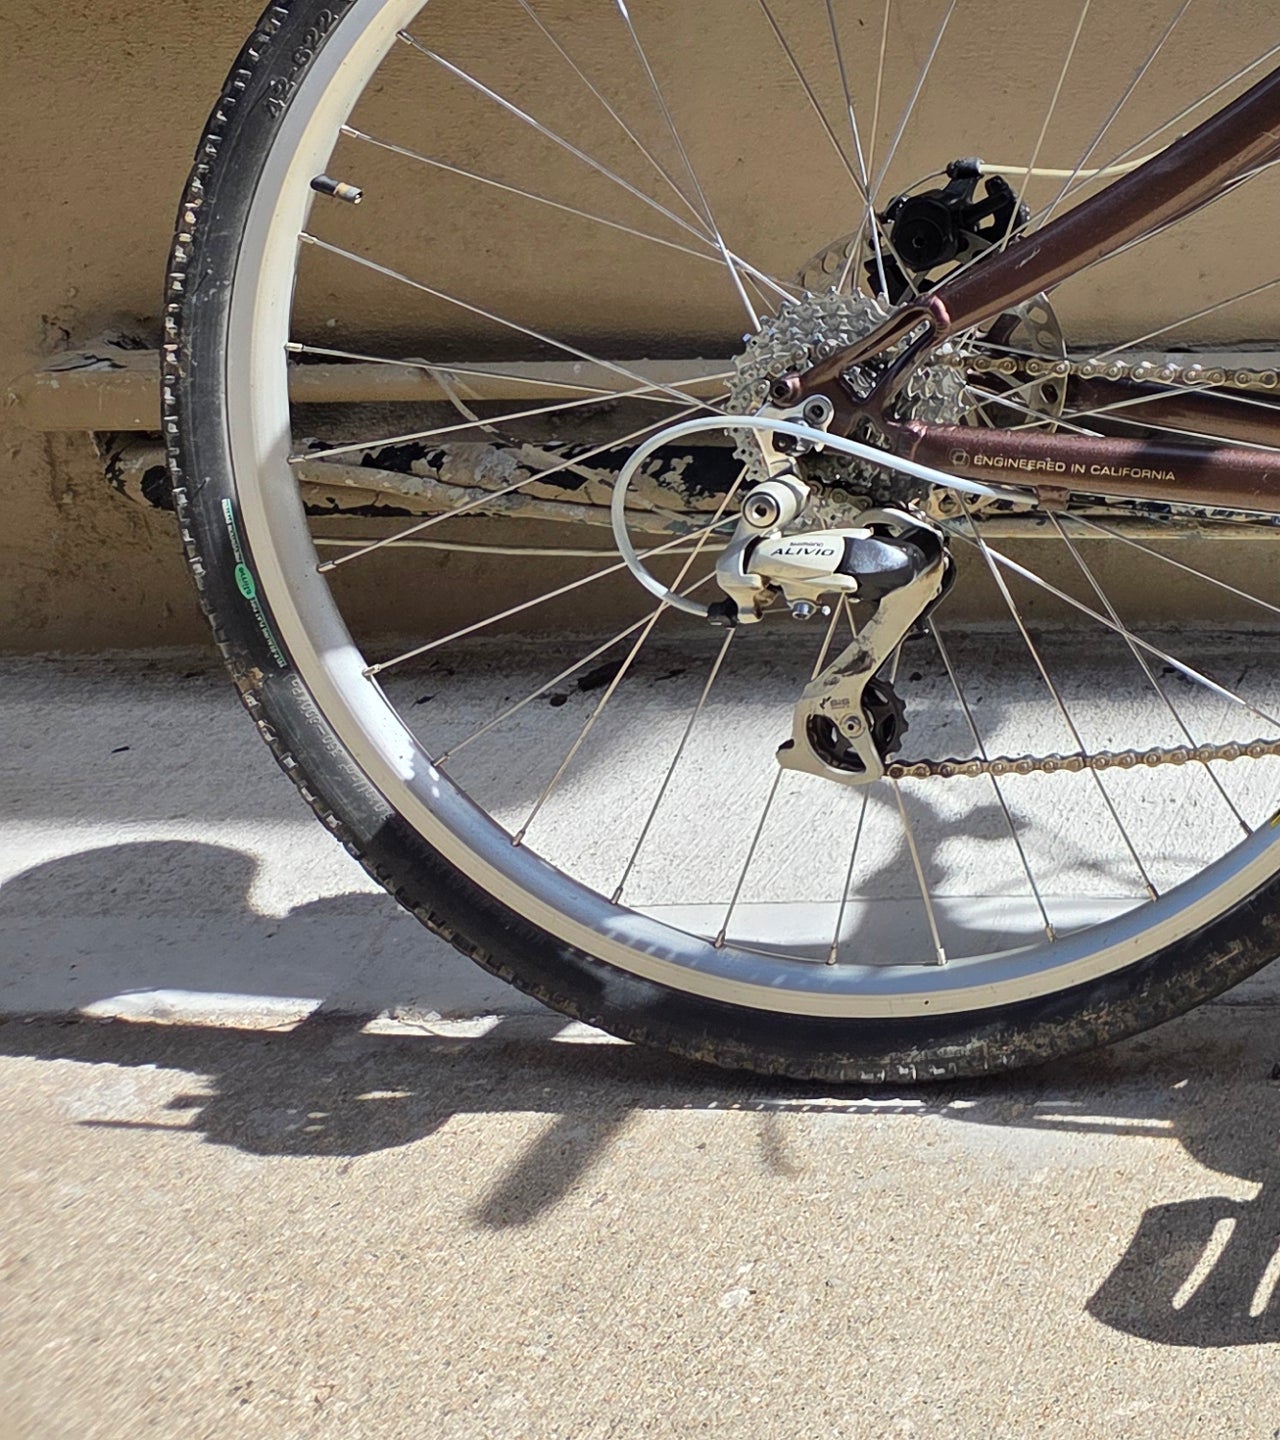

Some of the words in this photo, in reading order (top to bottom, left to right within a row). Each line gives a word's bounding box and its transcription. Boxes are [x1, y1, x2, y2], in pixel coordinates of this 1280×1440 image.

[973, 454, 1066, 472] ENGINEERED
[1071, 463, 1085, 474] IN
[1090, 464, 1175, 480] CALIFORNIA
[770, 548, 835, 556] ALIVIO
[238, 566, 253, 596] slime
